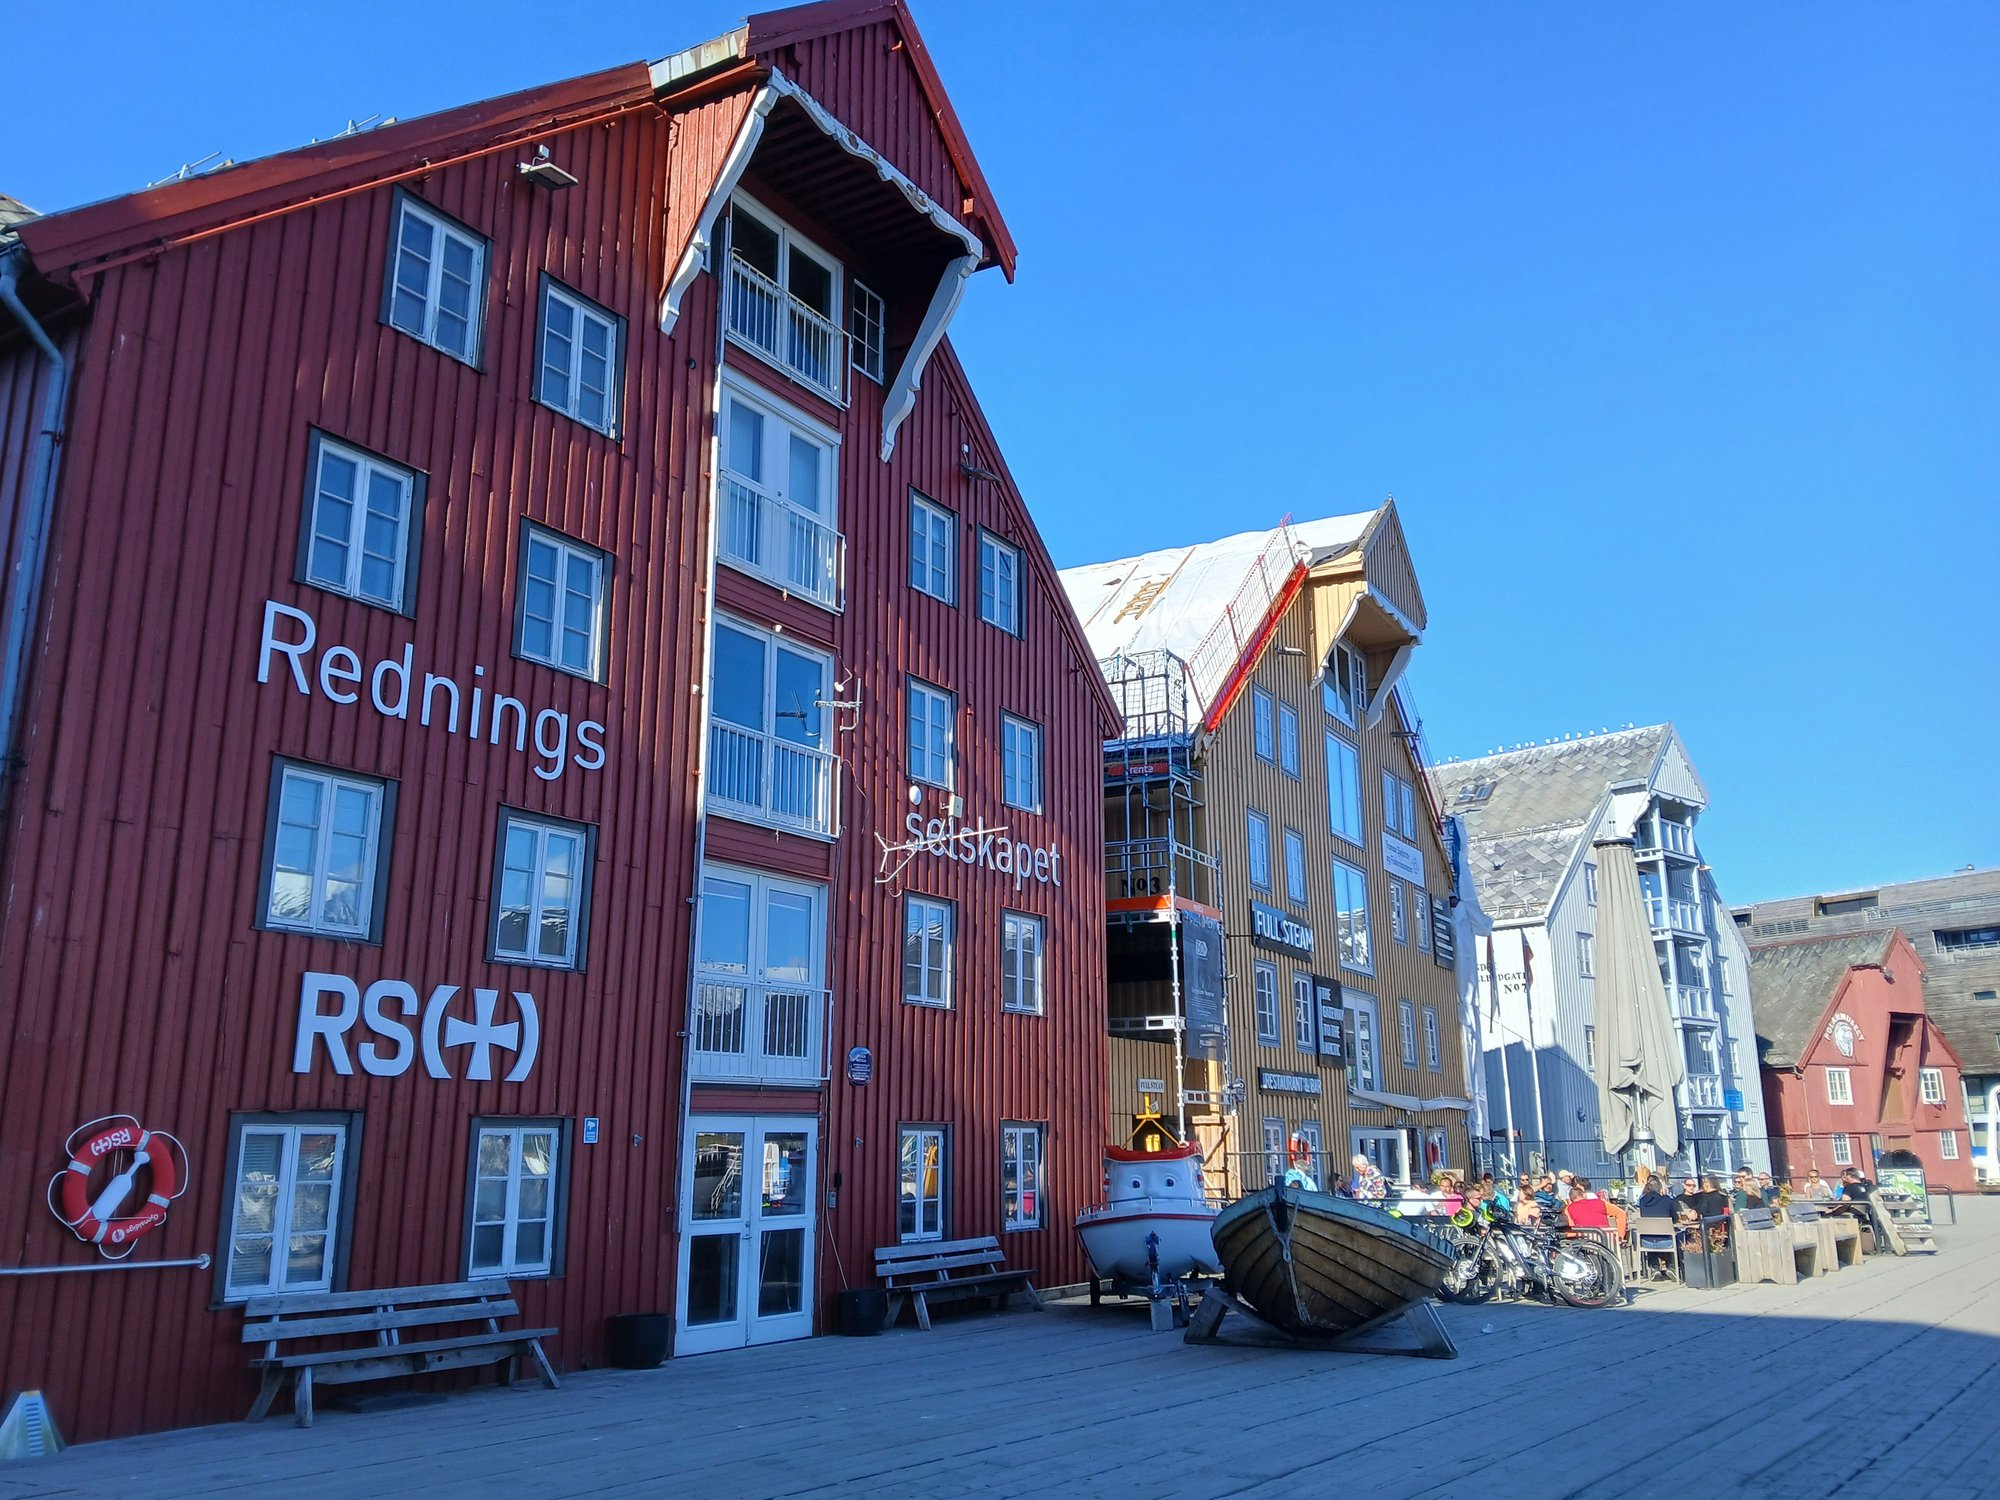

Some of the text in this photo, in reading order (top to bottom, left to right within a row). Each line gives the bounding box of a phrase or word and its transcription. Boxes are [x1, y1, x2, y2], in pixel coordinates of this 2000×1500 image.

[257, 599, 607, 781] Rednings
[1254, 909, 1315, 953] FULL STEAM
[1262, 1072, 1304, 1092] RESTAURANT
